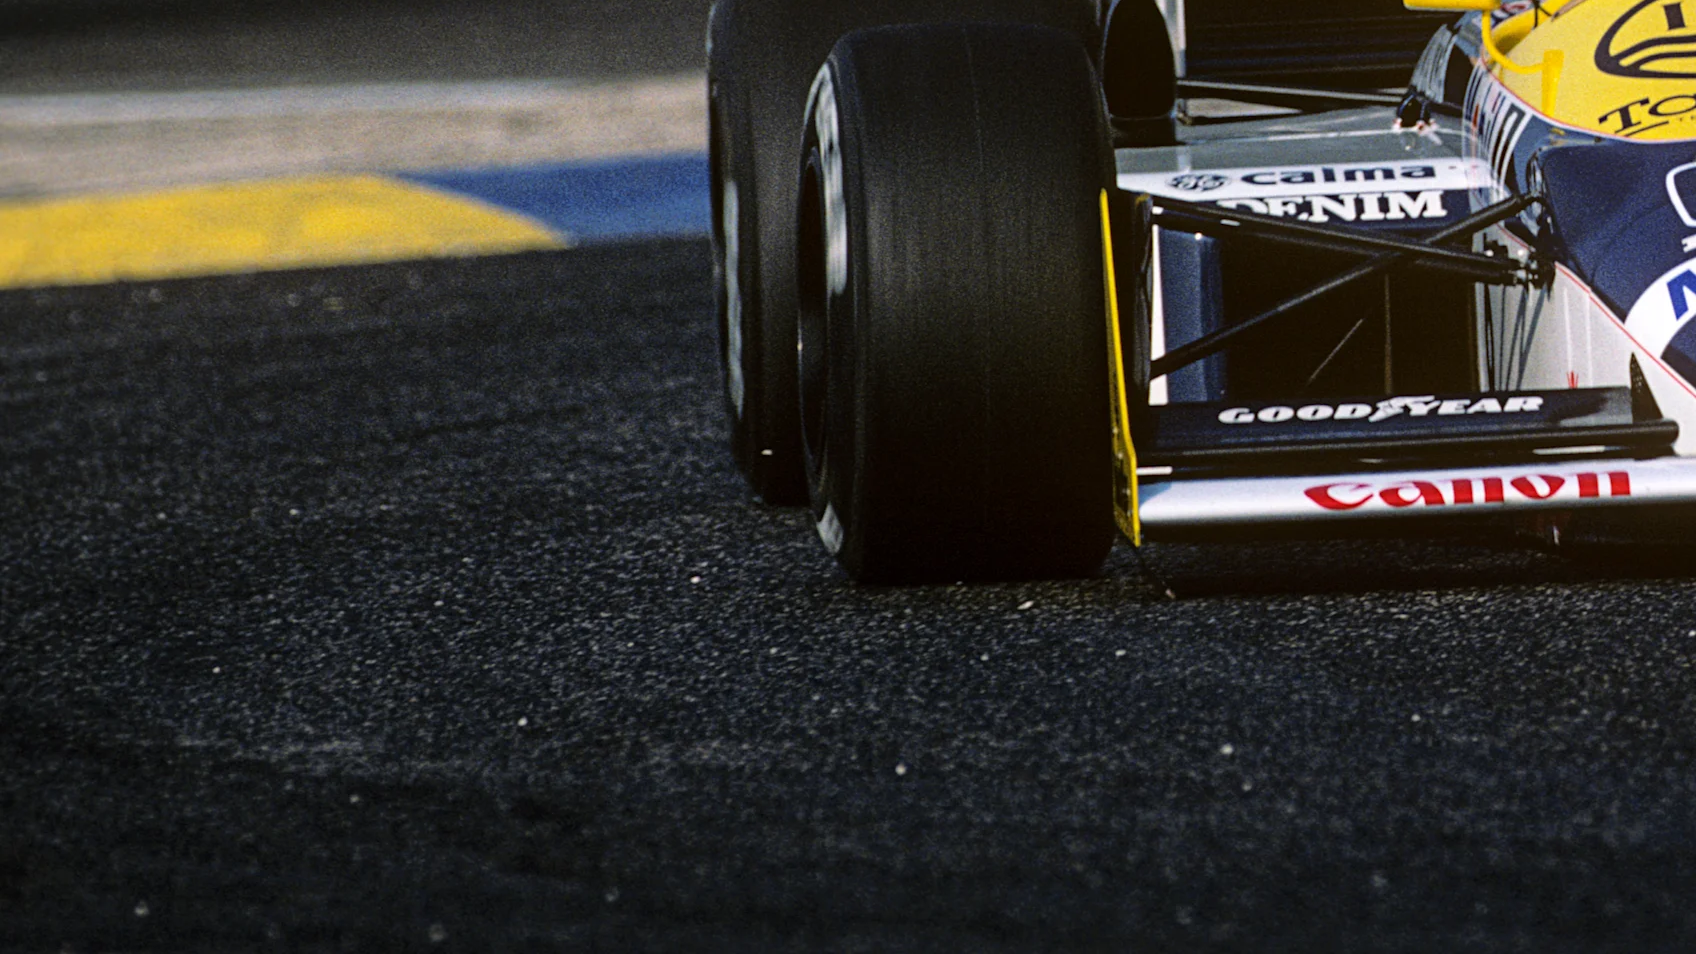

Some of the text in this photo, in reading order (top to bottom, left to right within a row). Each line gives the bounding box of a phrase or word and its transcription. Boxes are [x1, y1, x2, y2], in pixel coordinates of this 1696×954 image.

[1241, 163, 1436, 187] calma
[1218, 394, 1543, 424] GOODYEAR
[1303, 470, 1632, 511] Canon
